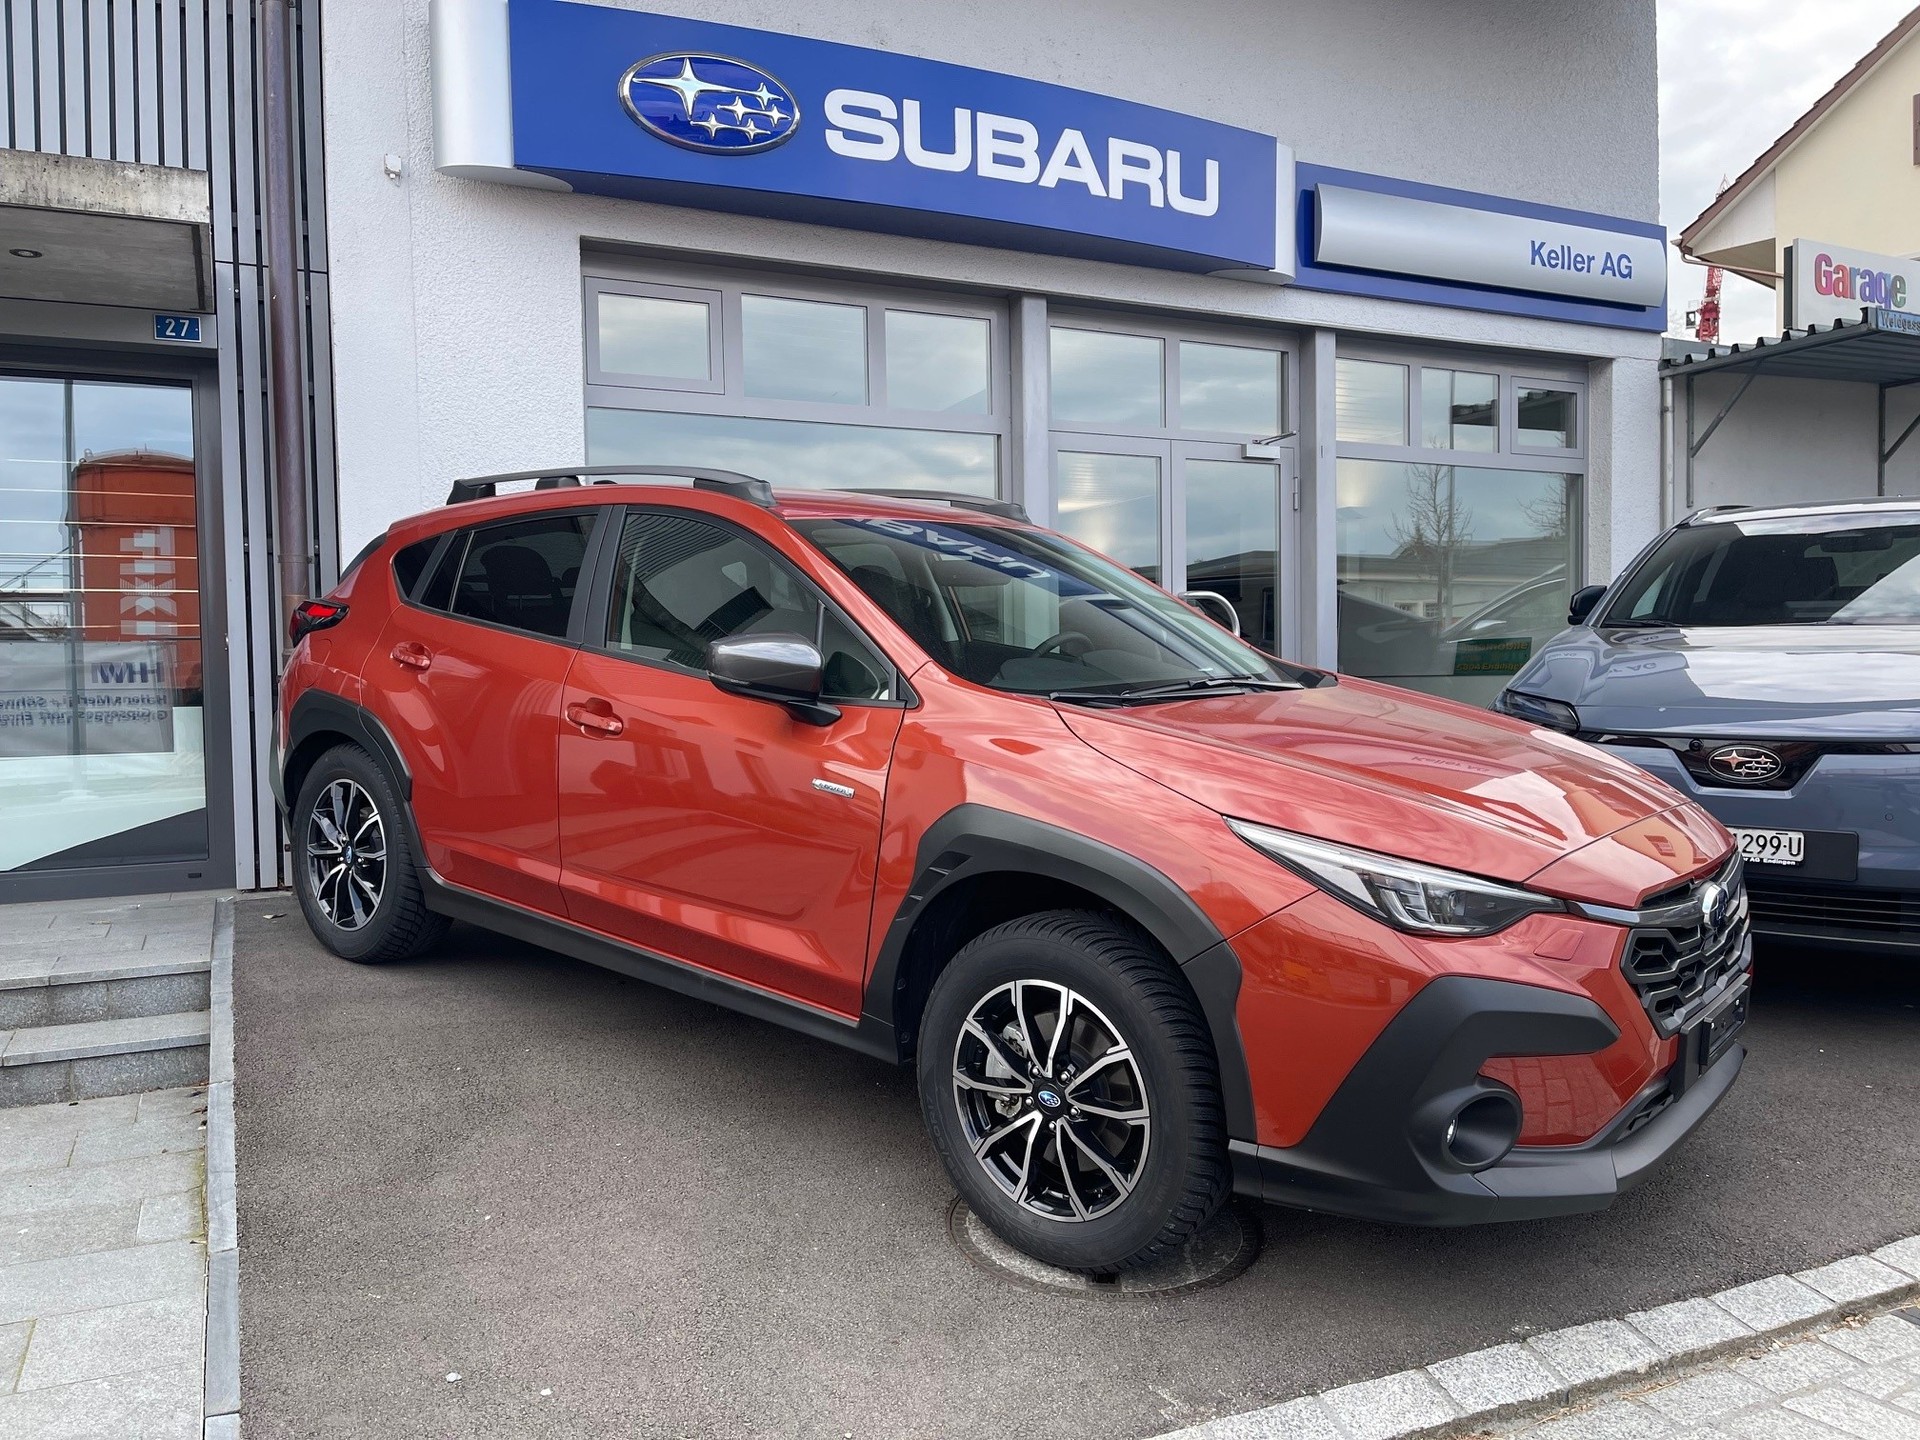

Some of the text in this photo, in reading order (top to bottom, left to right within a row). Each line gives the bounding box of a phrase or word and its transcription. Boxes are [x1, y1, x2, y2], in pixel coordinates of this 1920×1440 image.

[824, 89, 1219, 217] SUBARU
[1530, 240, 1632, 279] Keller AG
[1814, 253, 1906, 310] Garage
[165, 318, 189, 337] 27
[1763, 858, 1796, 866] Endingen
